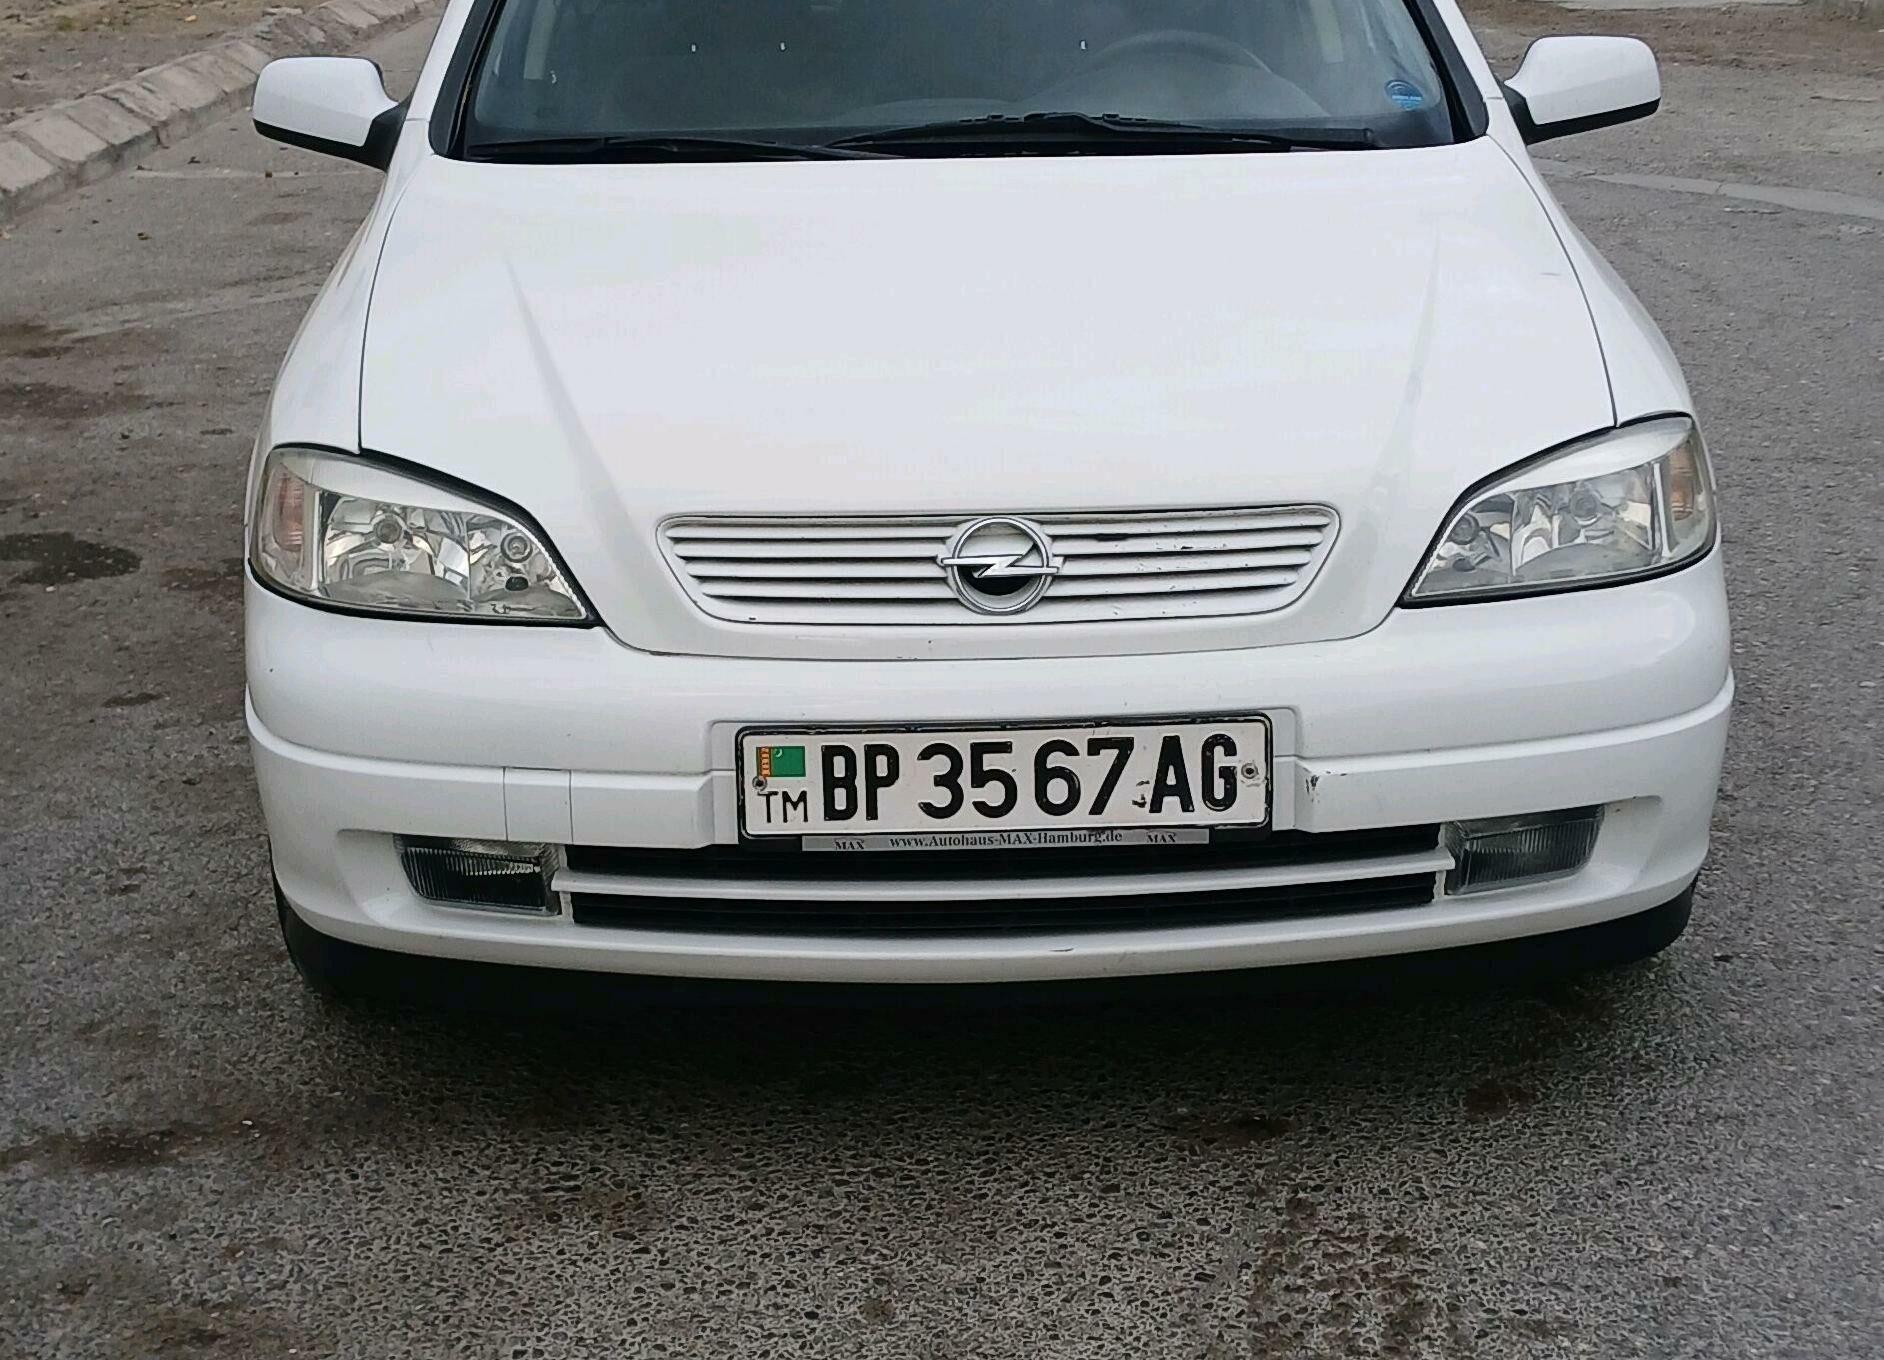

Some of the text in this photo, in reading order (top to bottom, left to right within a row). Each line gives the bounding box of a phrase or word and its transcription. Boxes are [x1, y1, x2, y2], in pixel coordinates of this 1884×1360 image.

[821, 733, 1238, 821] BP 35 67 AG
[757, 790, 809, 824] TM
[834, 830, 1178, 850] MAX www.Autohaus-MAX-Hamburg.de MAX
